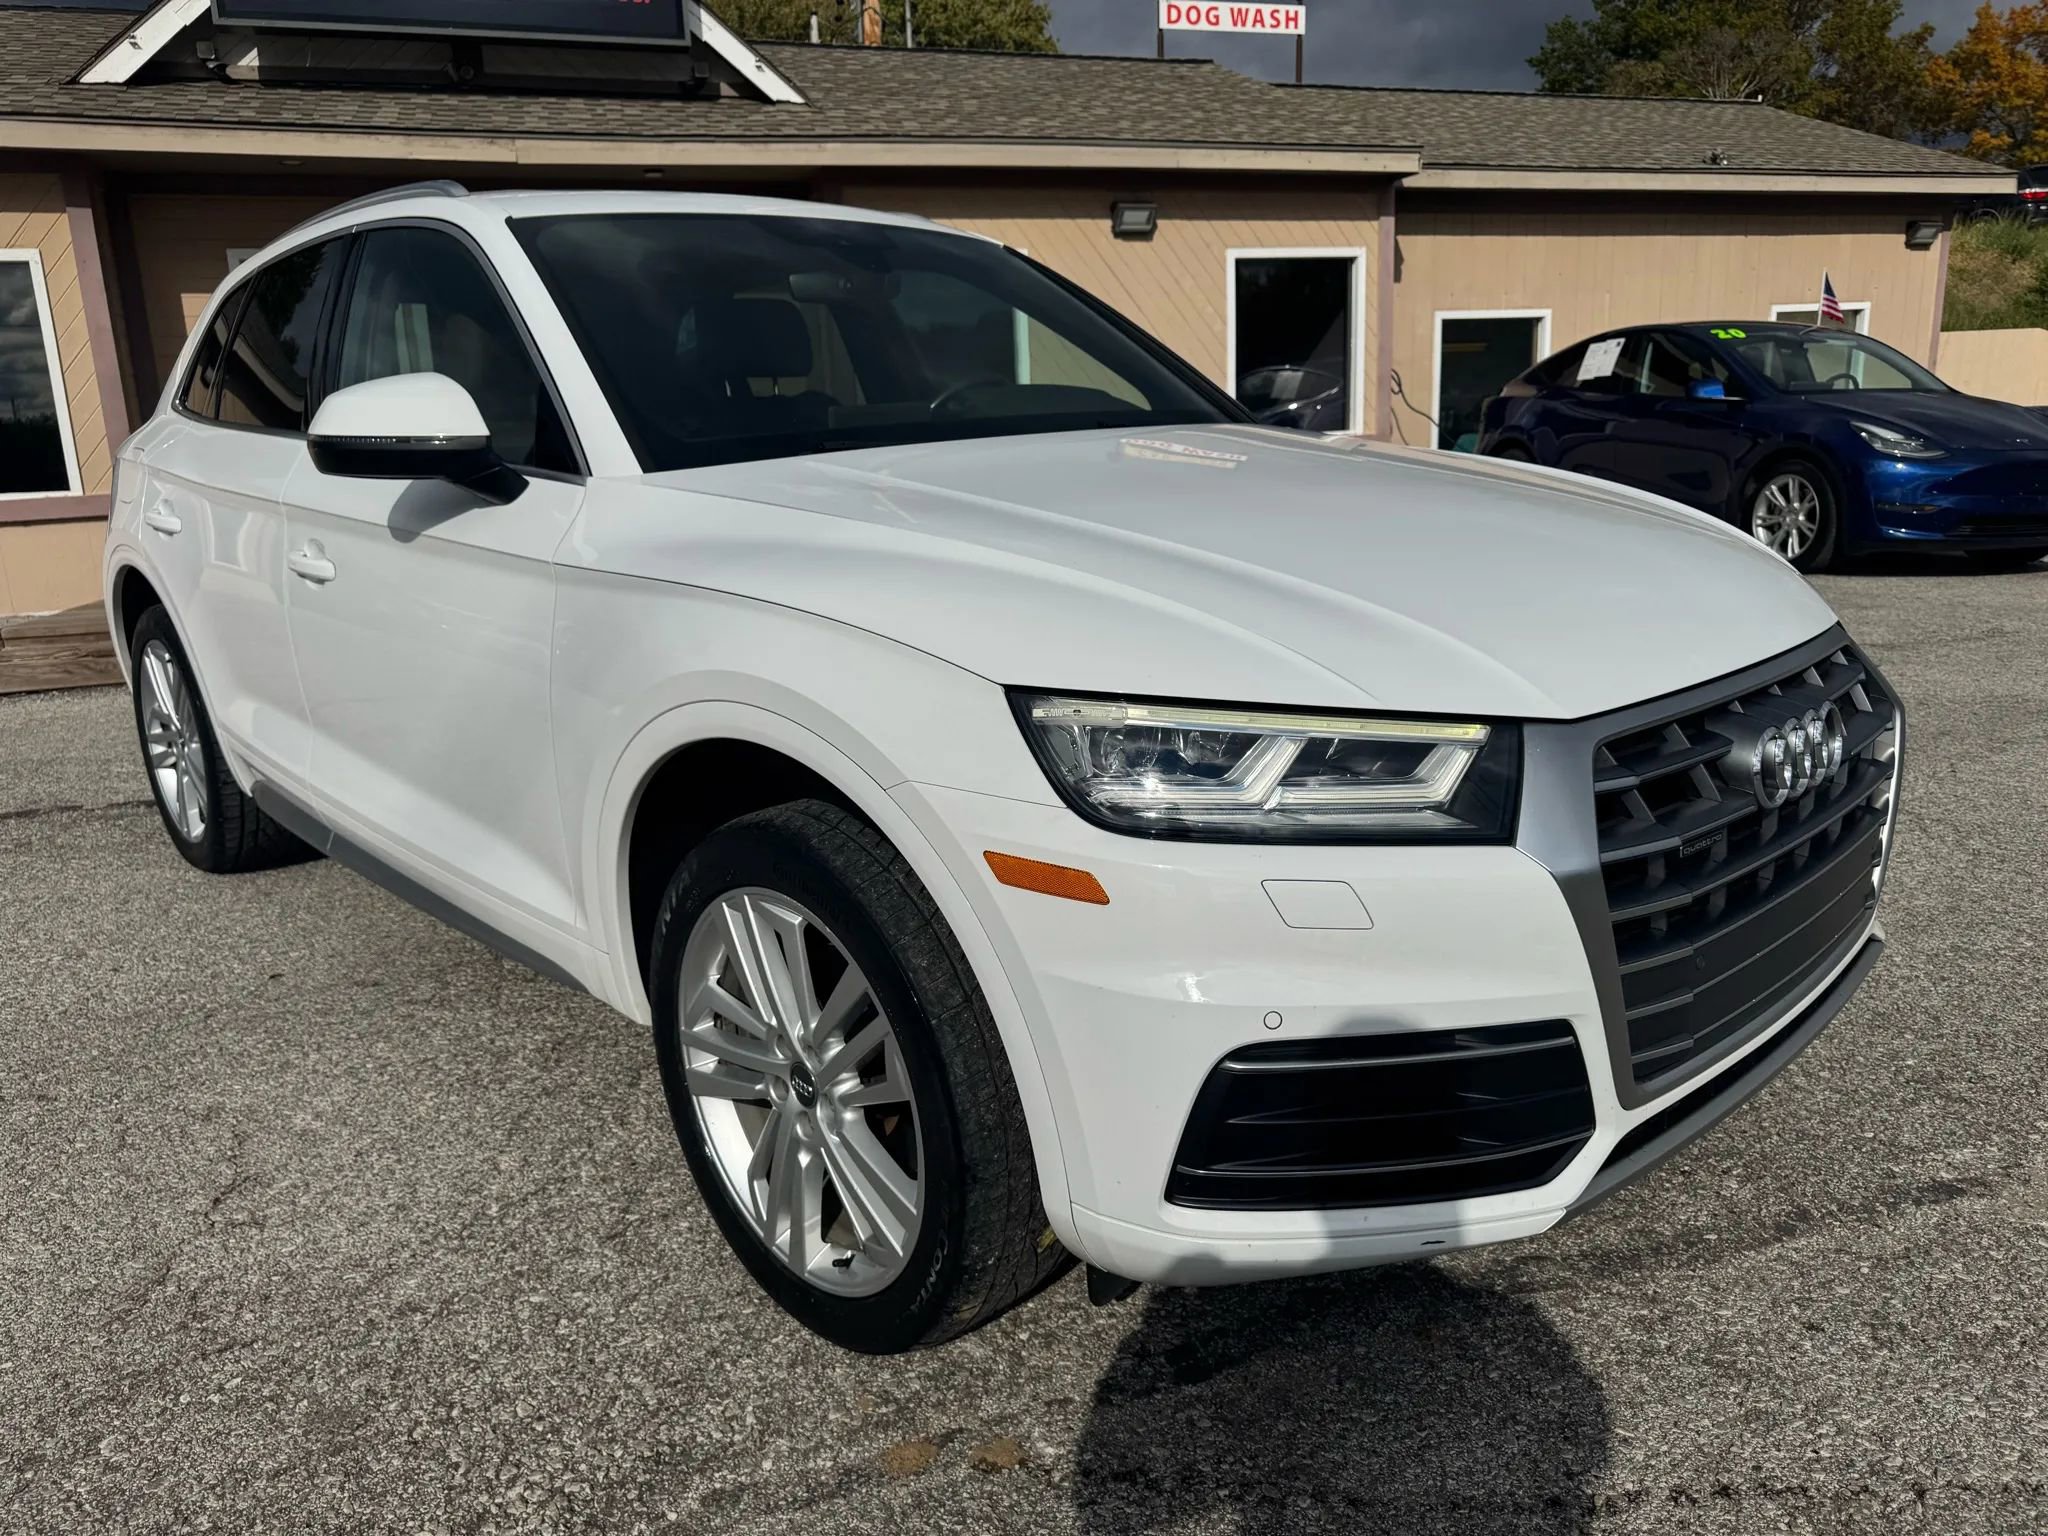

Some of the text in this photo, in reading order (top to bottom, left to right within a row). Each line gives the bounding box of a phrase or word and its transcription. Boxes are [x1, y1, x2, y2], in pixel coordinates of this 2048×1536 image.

[1167, 4, 1299, 30] DOG WASH
[1710, 328, 1747, 339] 20
[1683, 833, 1723, 857] quattro
